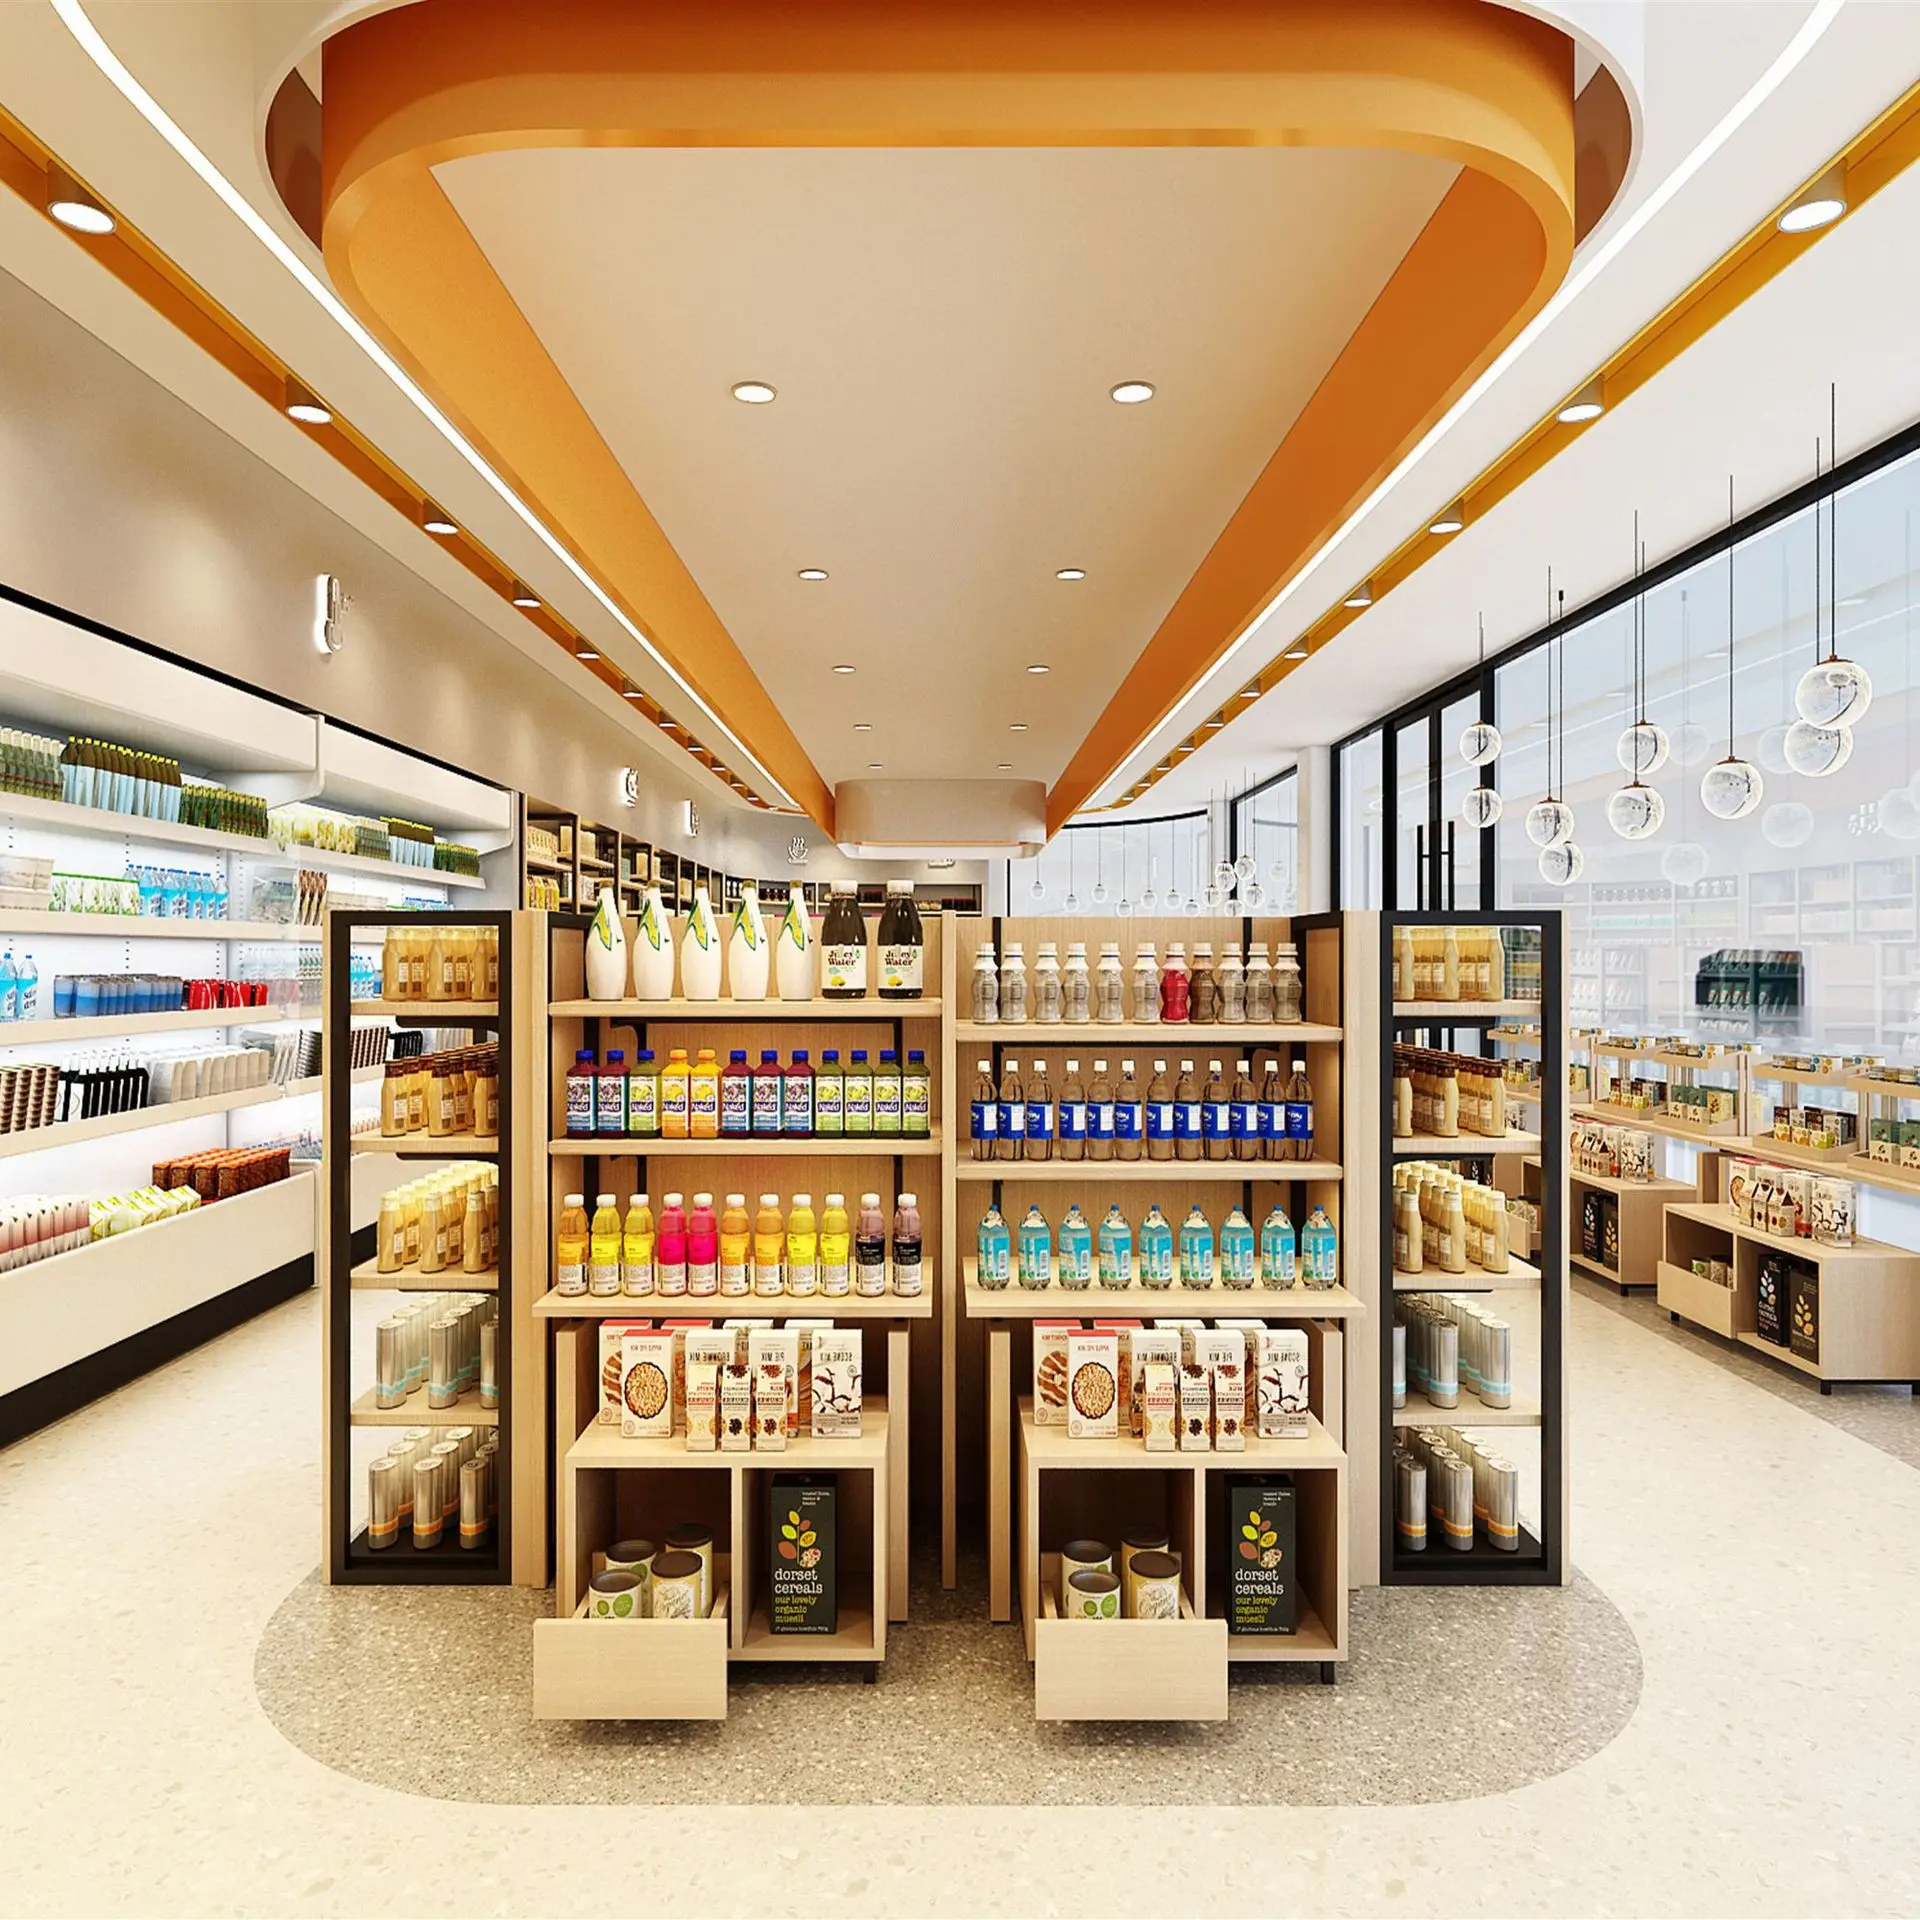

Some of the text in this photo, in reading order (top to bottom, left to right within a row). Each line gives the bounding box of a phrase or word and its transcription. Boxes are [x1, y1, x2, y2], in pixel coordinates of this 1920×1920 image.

[828, 958, 857, 966] Water
[885, 958, 913, 966] Water
[774, 1568, 818, 1580] dorset
[1235, 1568, 1279, 1581] dorset
[774, 1581, 823, 1594] cereals
[1235, 1582, 1284, 1595] cereals
[791, 1595, 818, 1605] lovely
[1253, 1596, 1278, 1605] lovely
[775, 1605, 807, 1614] organic
[1235, 1605, 1268, 1615] organic
